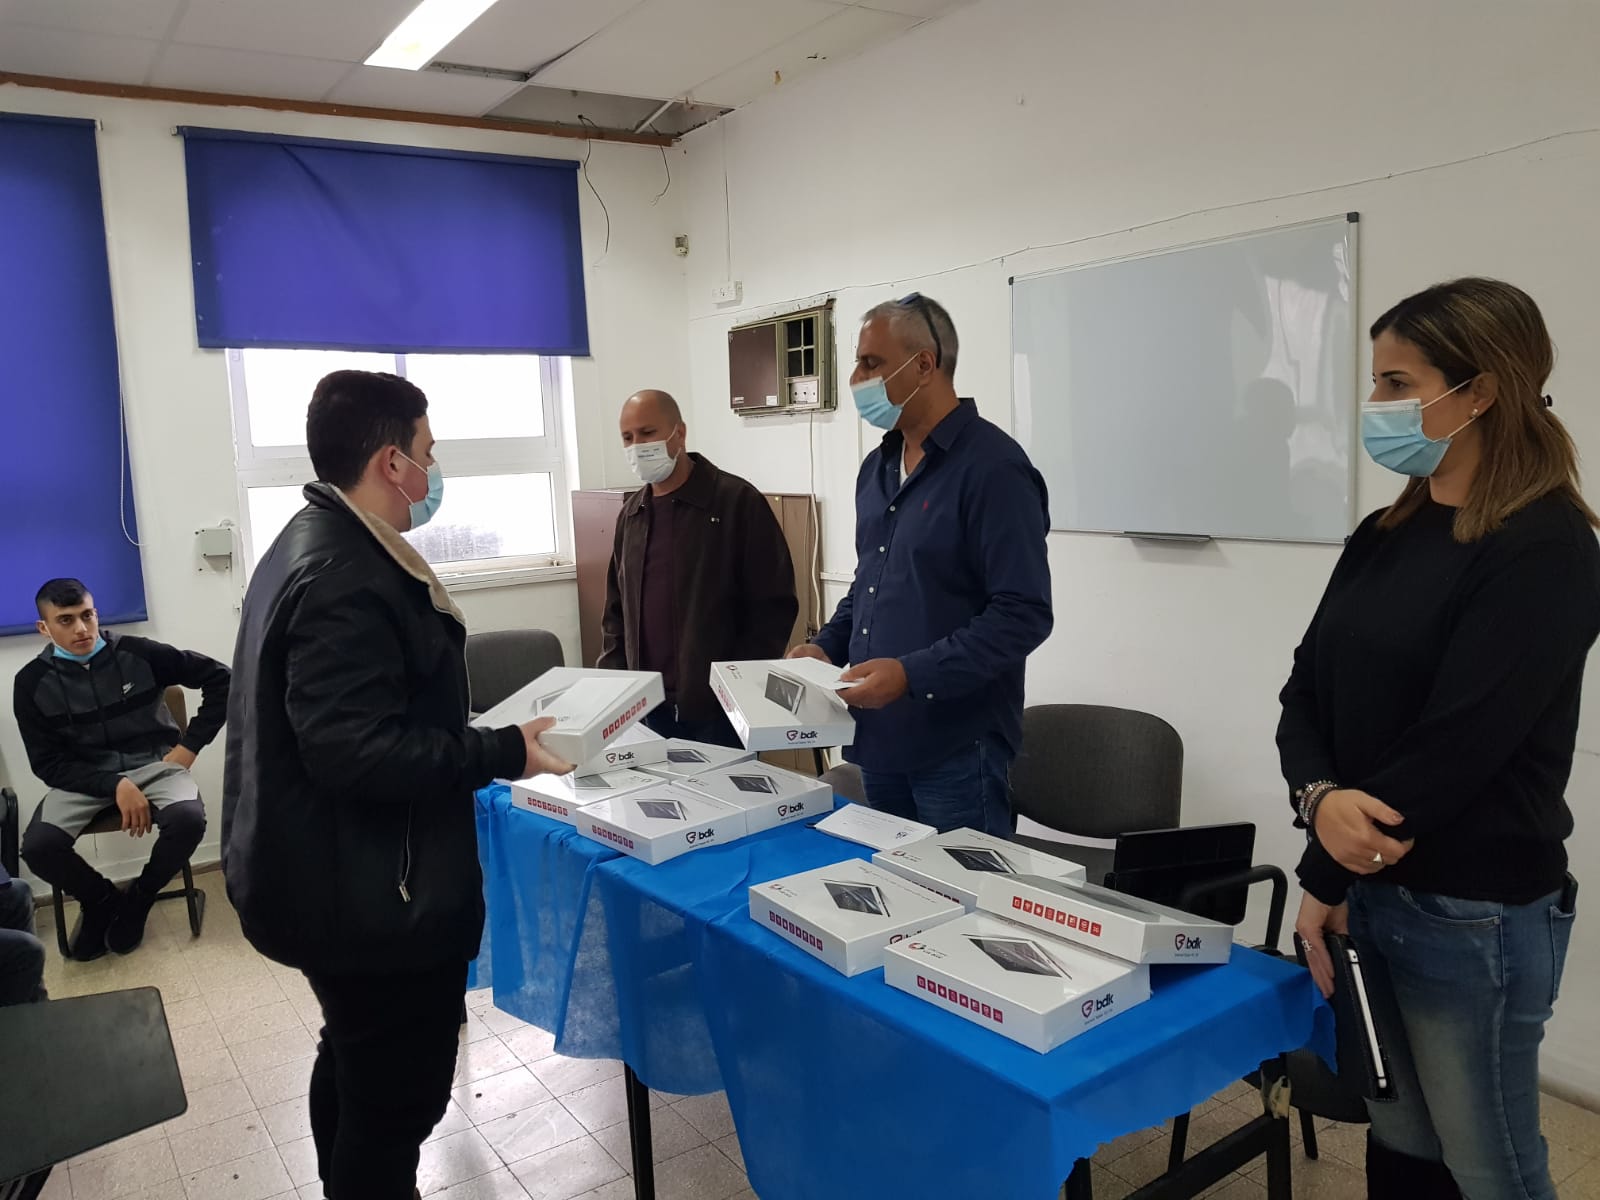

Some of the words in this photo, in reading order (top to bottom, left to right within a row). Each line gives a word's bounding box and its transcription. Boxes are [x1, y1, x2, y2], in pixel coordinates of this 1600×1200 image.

[800, 730, 818, 739] bdk
[618, 751, 635, 761] bdk
[789, 801, 804, 813] bdk
[698, 828, 714, 840] bdk
[1186, 936, 1202, 950] bdk
[1096, 993, 1114, 1011] bdk
